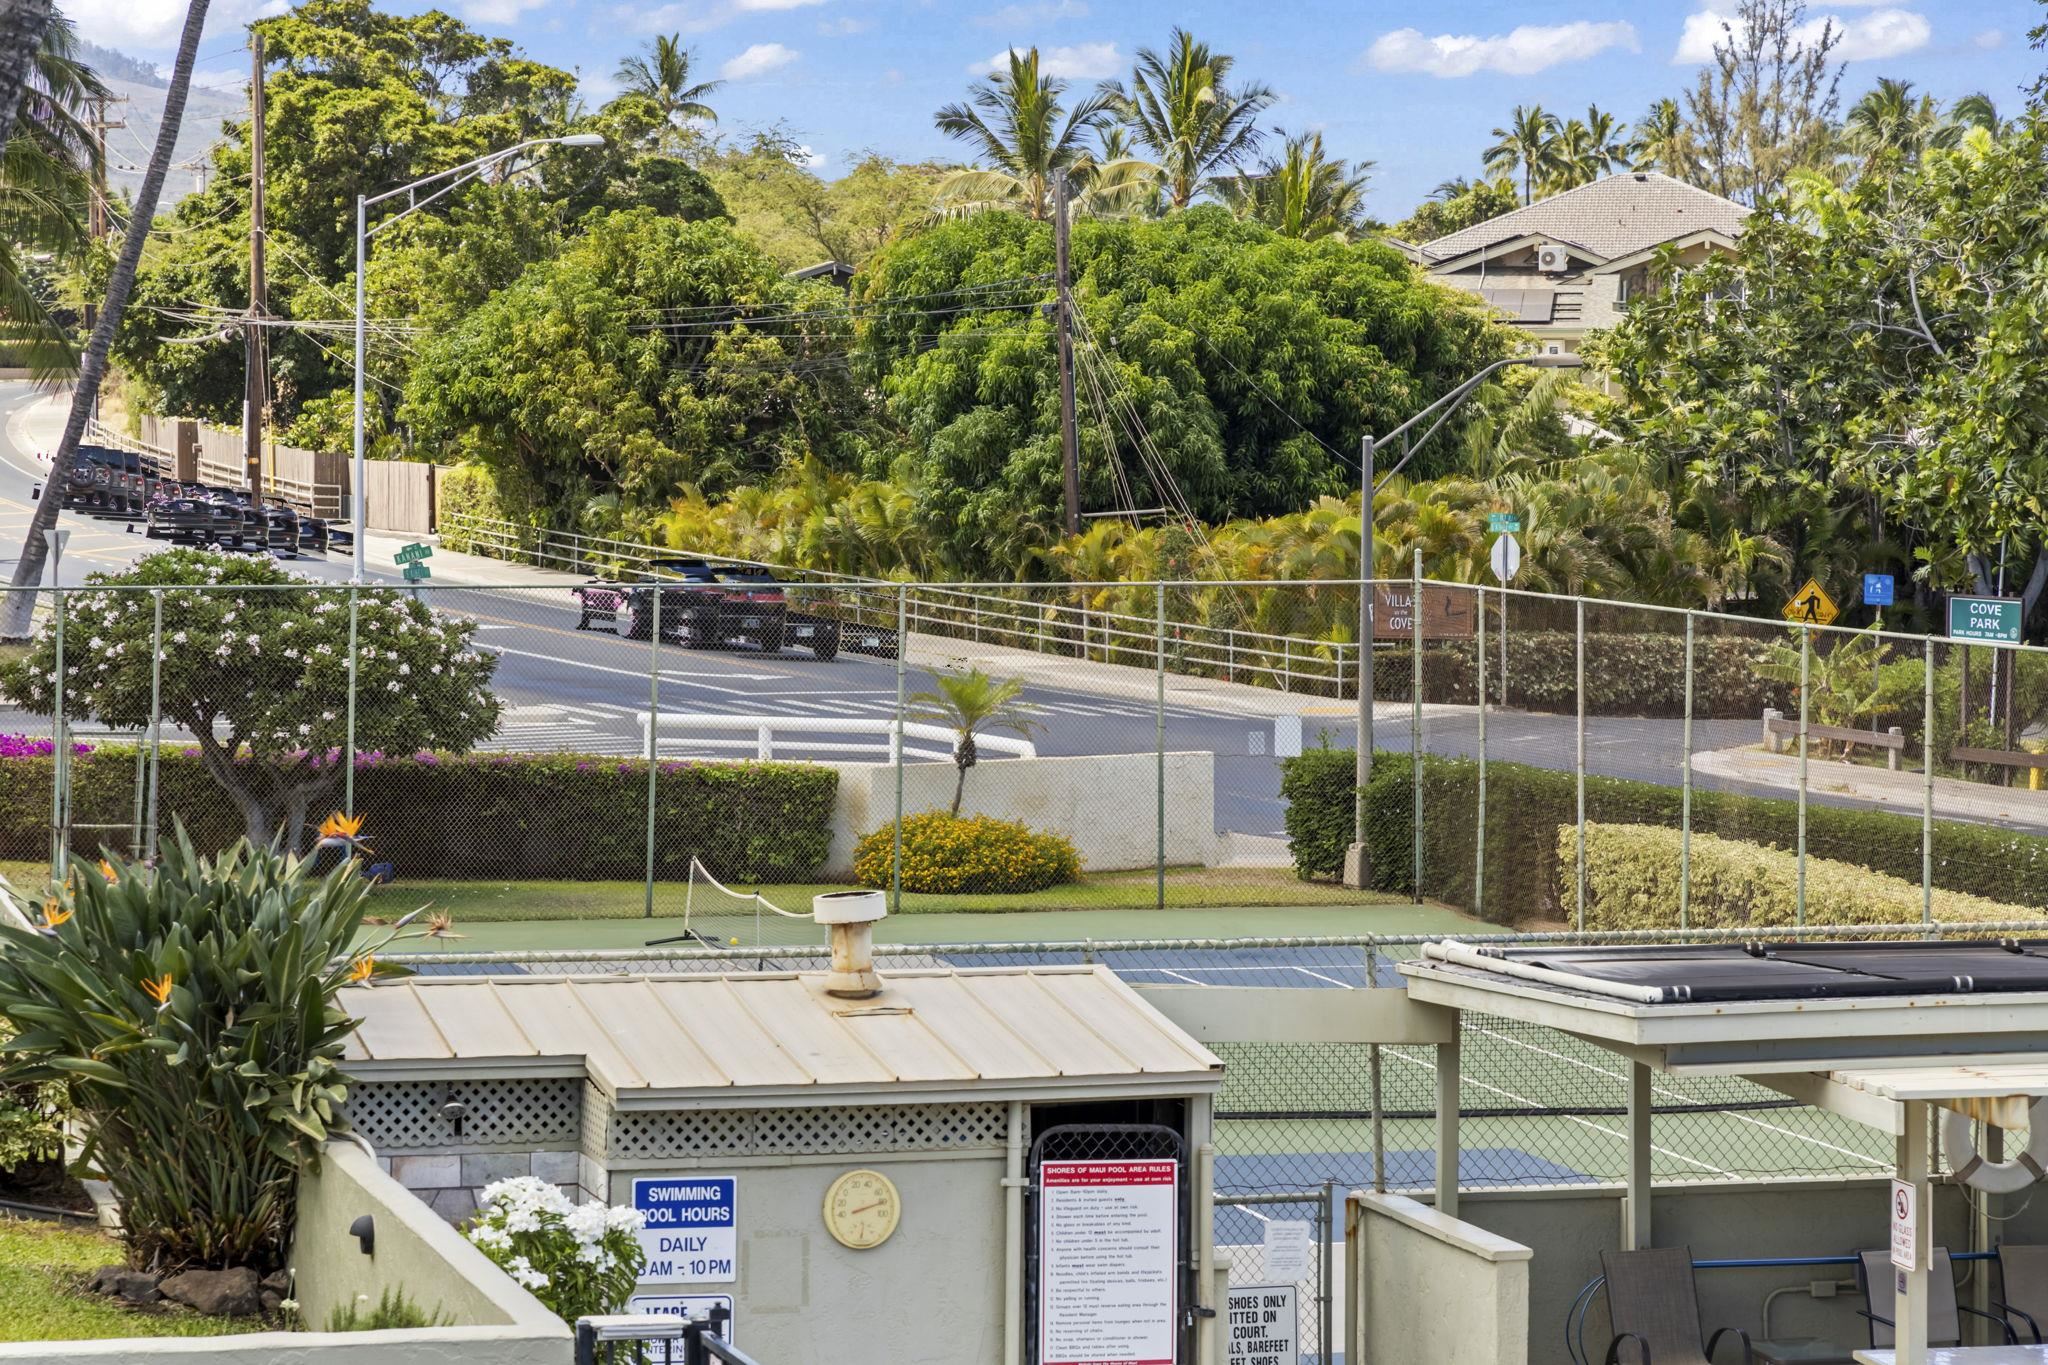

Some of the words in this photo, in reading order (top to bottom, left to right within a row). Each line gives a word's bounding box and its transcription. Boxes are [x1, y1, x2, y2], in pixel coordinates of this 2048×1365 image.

[1384, 595, 1416, 607] VILLA
[1970, 602, 2002, 616] COVE
[1390, 618, 1413, 630] COVE
[1970, 617, 2000, 630] PARK
[1089, 1166, 1106, 1174] MAUI
[648, 1186, 720, 1203] SWIMMING
[681, 1206, 730, 1222] HOURS
[660, 1236, 707, 1253] DAILY
[650, 1261, 672, 1276] AM
[689, 1259, 706, 1275] 10
[709, 1259, 731, 1275] PM
[1229, 1296, 1258, 1310] SHOES
[1263, 1295, 1287, 1308] ONLY
[1229, 1311, 1258, 1325] ITTED
[1263, 1310, 1277, 1323] ON
[1233, 1326, 1269, 1340] COURT.
[1247, 1339, 1289, 1353] BAREFEET
